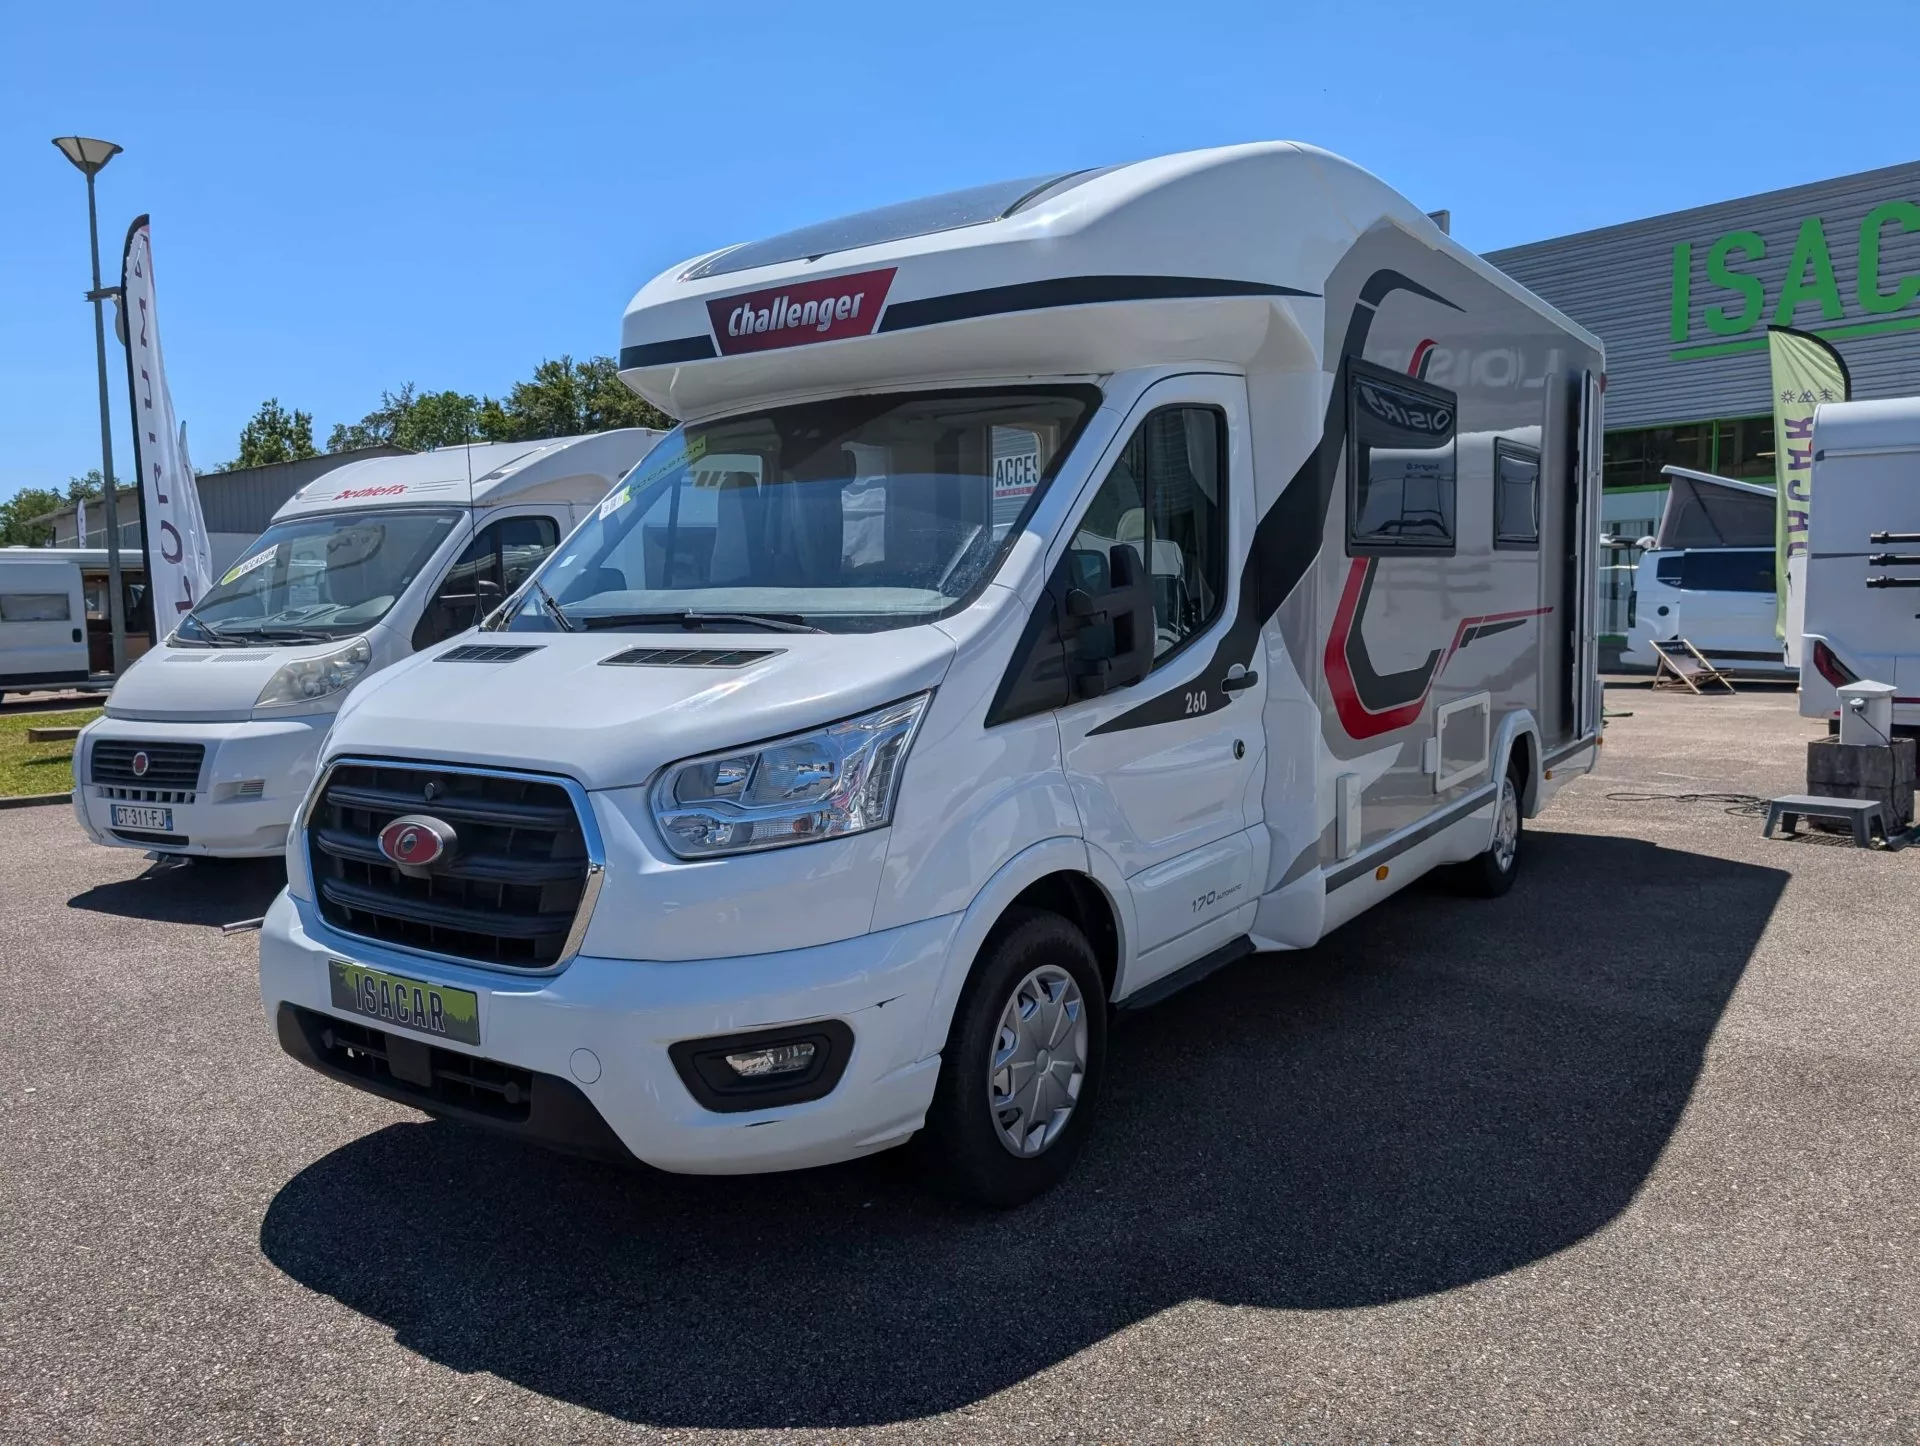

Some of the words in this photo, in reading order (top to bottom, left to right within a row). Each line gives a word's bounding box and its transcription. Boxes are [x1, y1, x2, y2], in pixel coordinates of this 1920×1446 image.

[728, 291, 865, 337] Challenger
[1184, 690, 1208, 714] 260
[117, 807, 166, 827] CT-311-FJ
[1191, 890, 1216, 913] 170
[354, 972, 446, 1033] ISACAR
